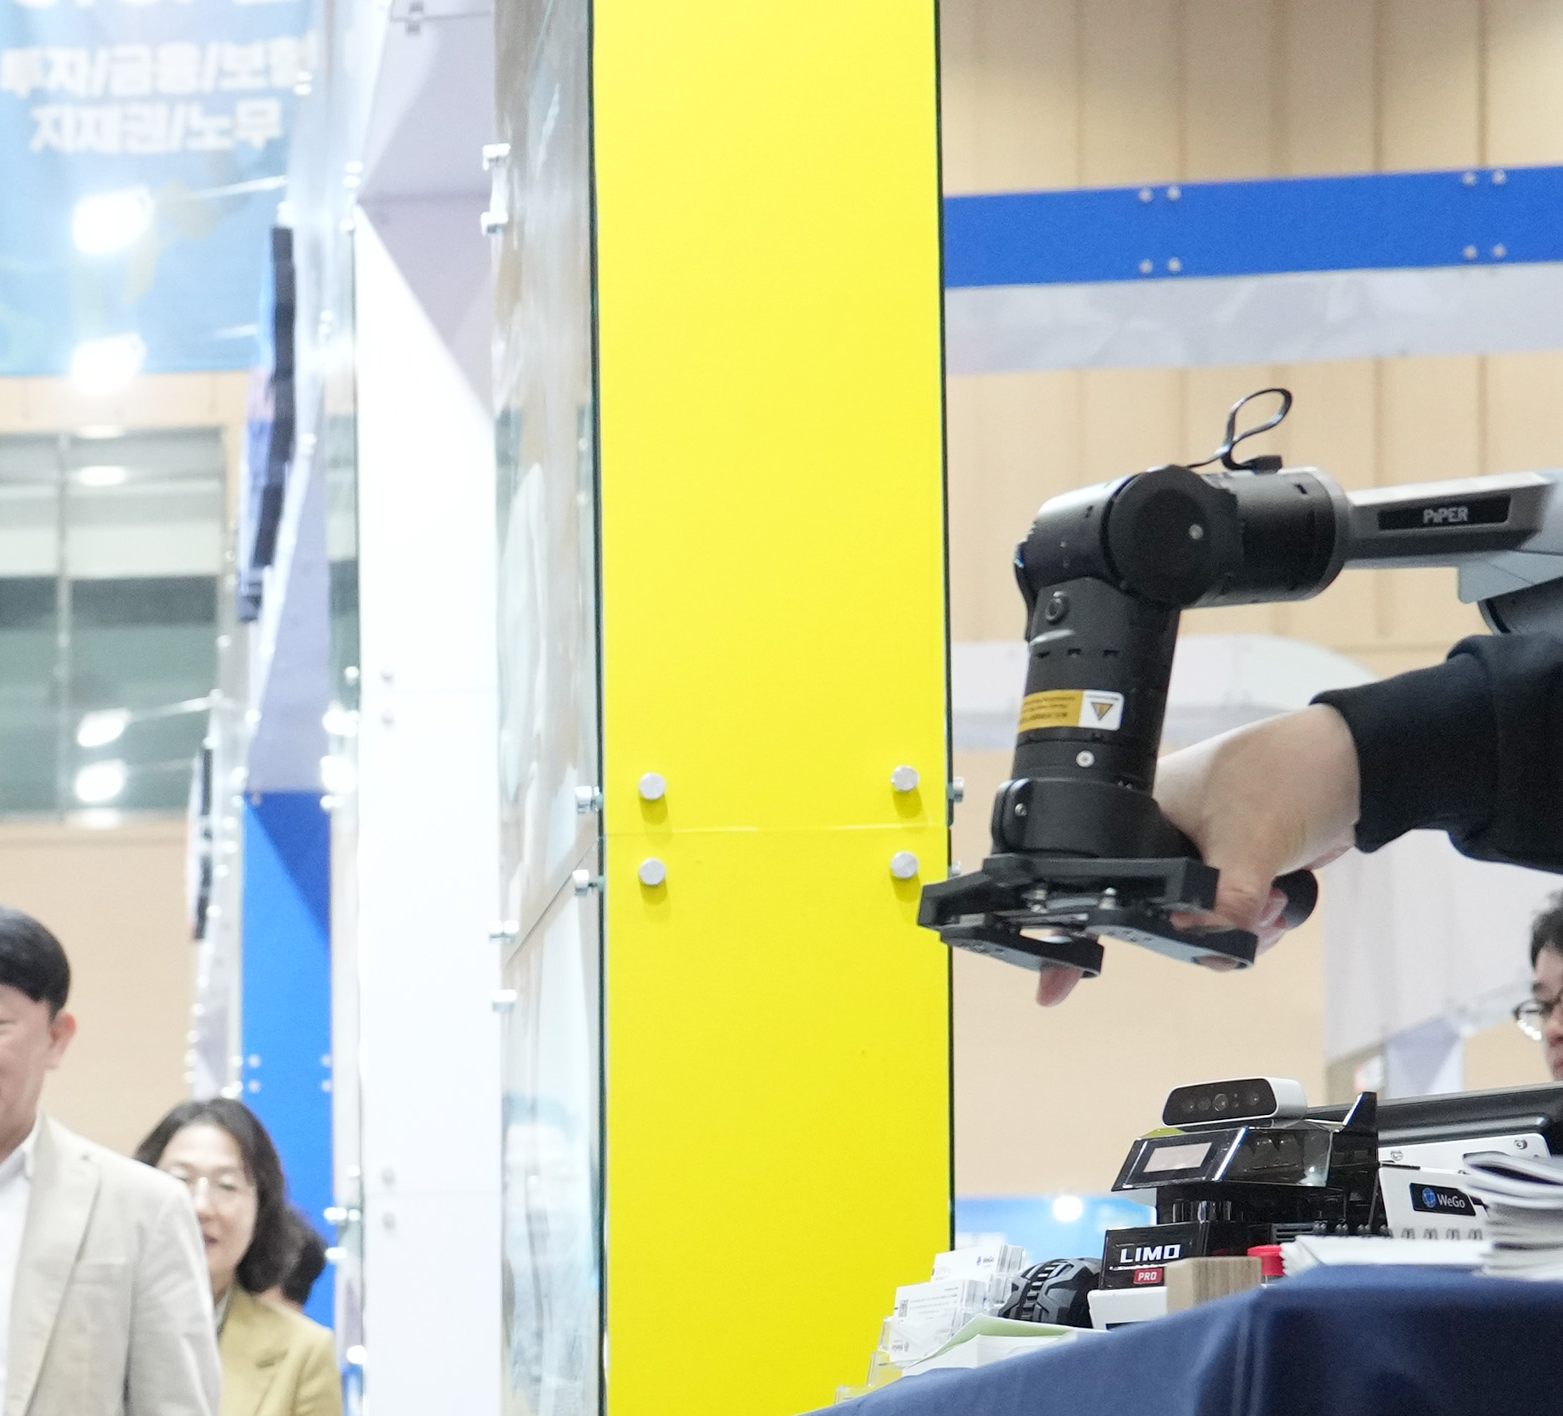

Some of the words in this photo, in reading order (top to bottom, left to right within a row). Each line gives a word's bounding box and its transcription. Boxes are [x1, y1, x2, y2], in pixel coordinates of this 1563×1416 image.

[1436, 1193, 1465, 1208] WeGo
[1120, 1244, 1181, 1263] LIMO
[1137, 1271, 1157, 1281] PRO
